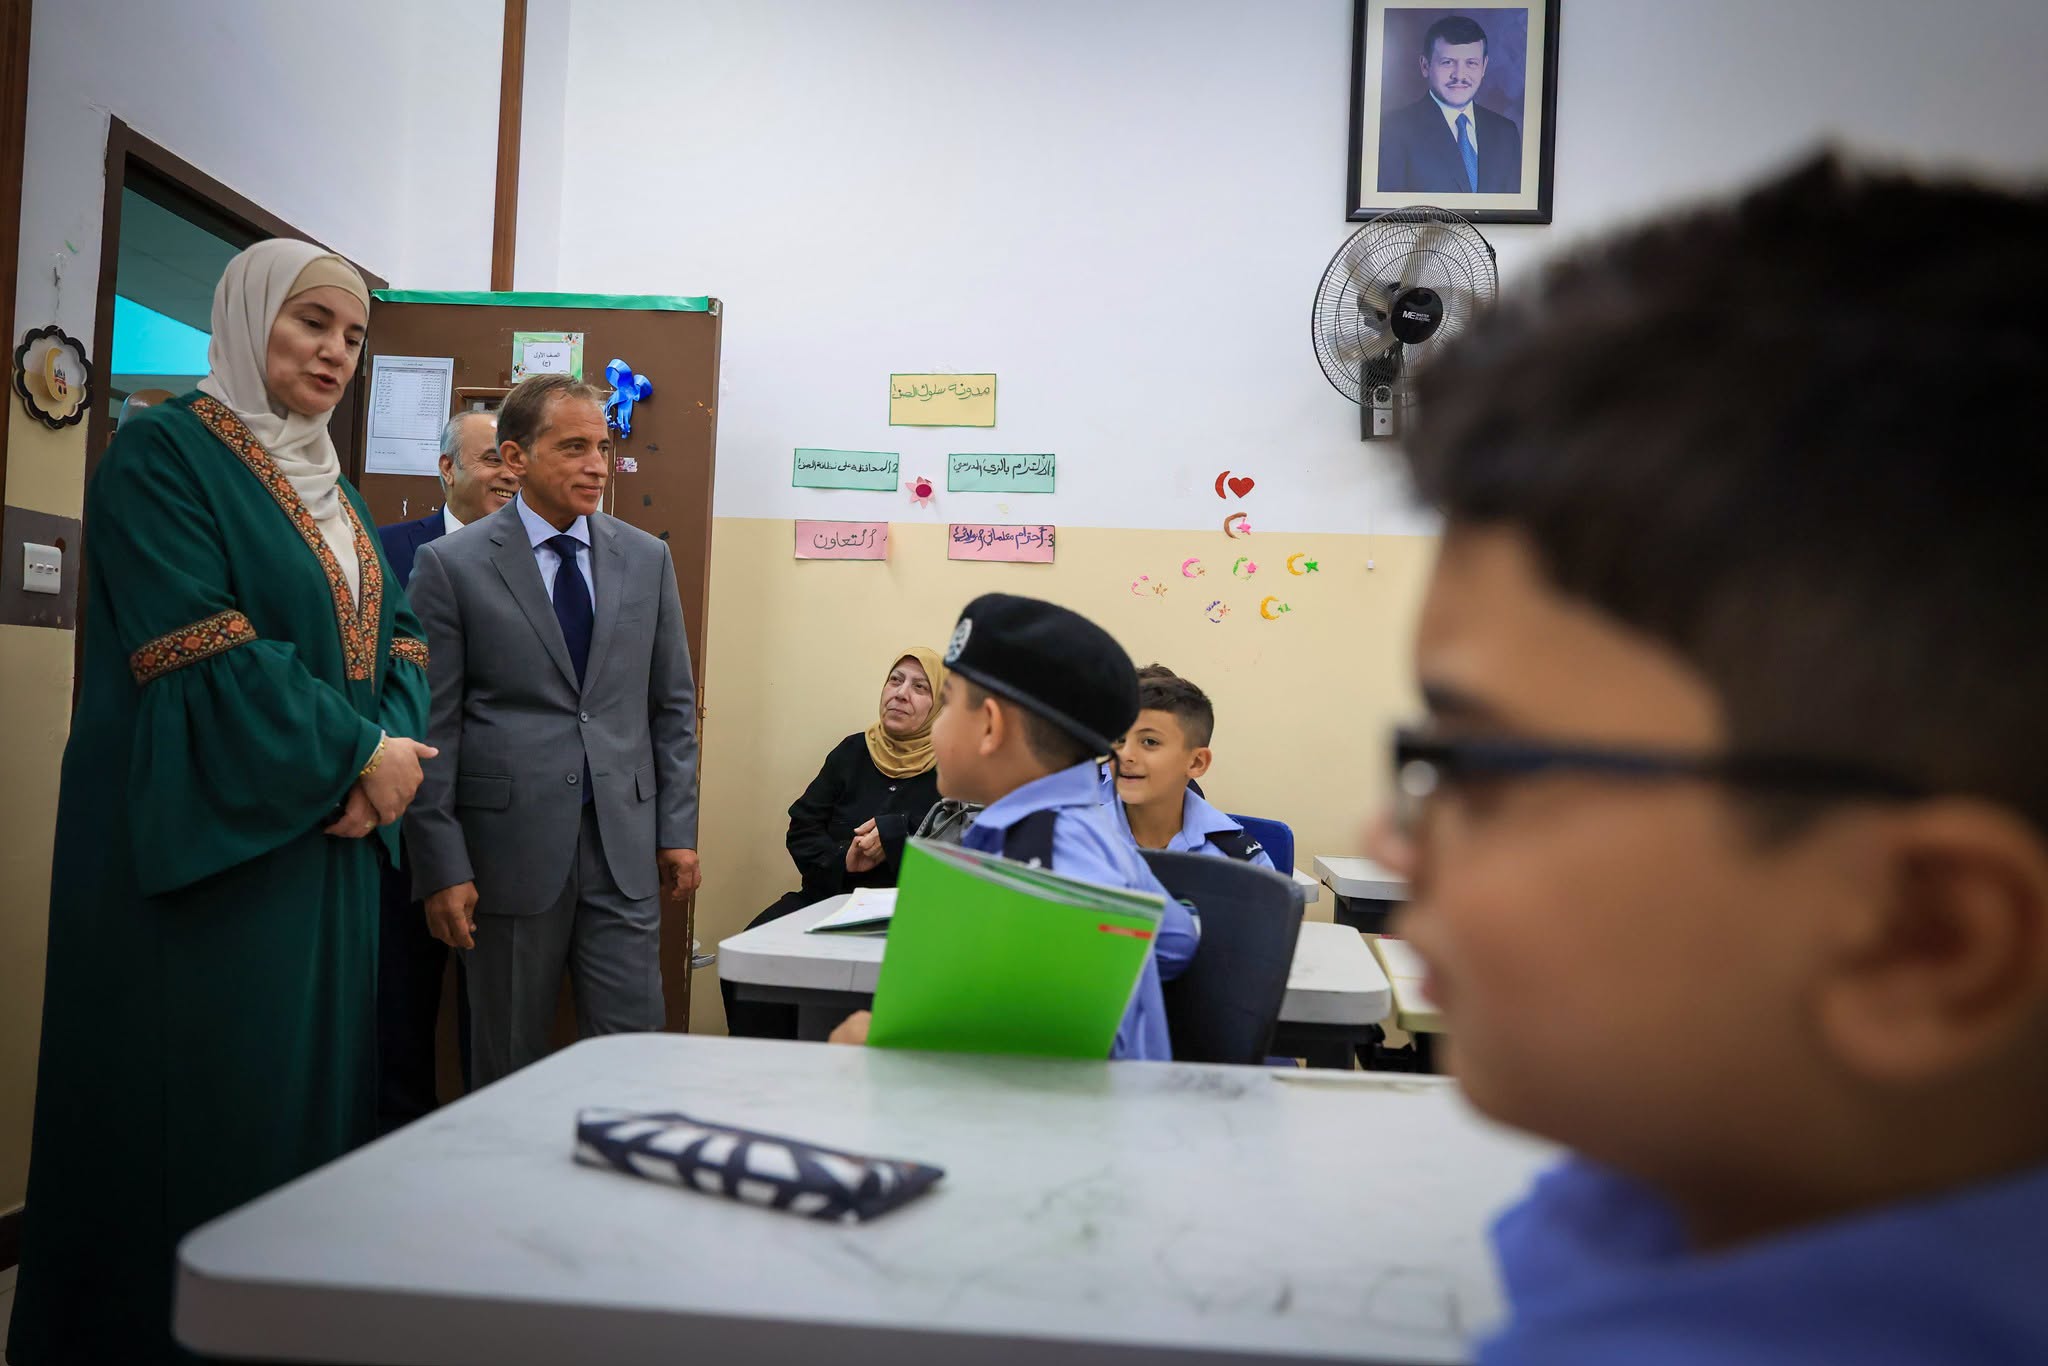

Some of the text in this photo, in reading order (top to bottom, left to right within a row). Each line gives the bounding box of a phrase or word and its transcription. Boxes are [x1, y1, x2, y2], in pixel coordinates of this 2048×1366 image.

[1402, 310, 1416, 320] ME
[918, 383, 946, 402] سلوك
[948, 383, 990, 400] مدونة
[837, 460, 851, 471] على
[813, 528, 877, 550] التعاون
